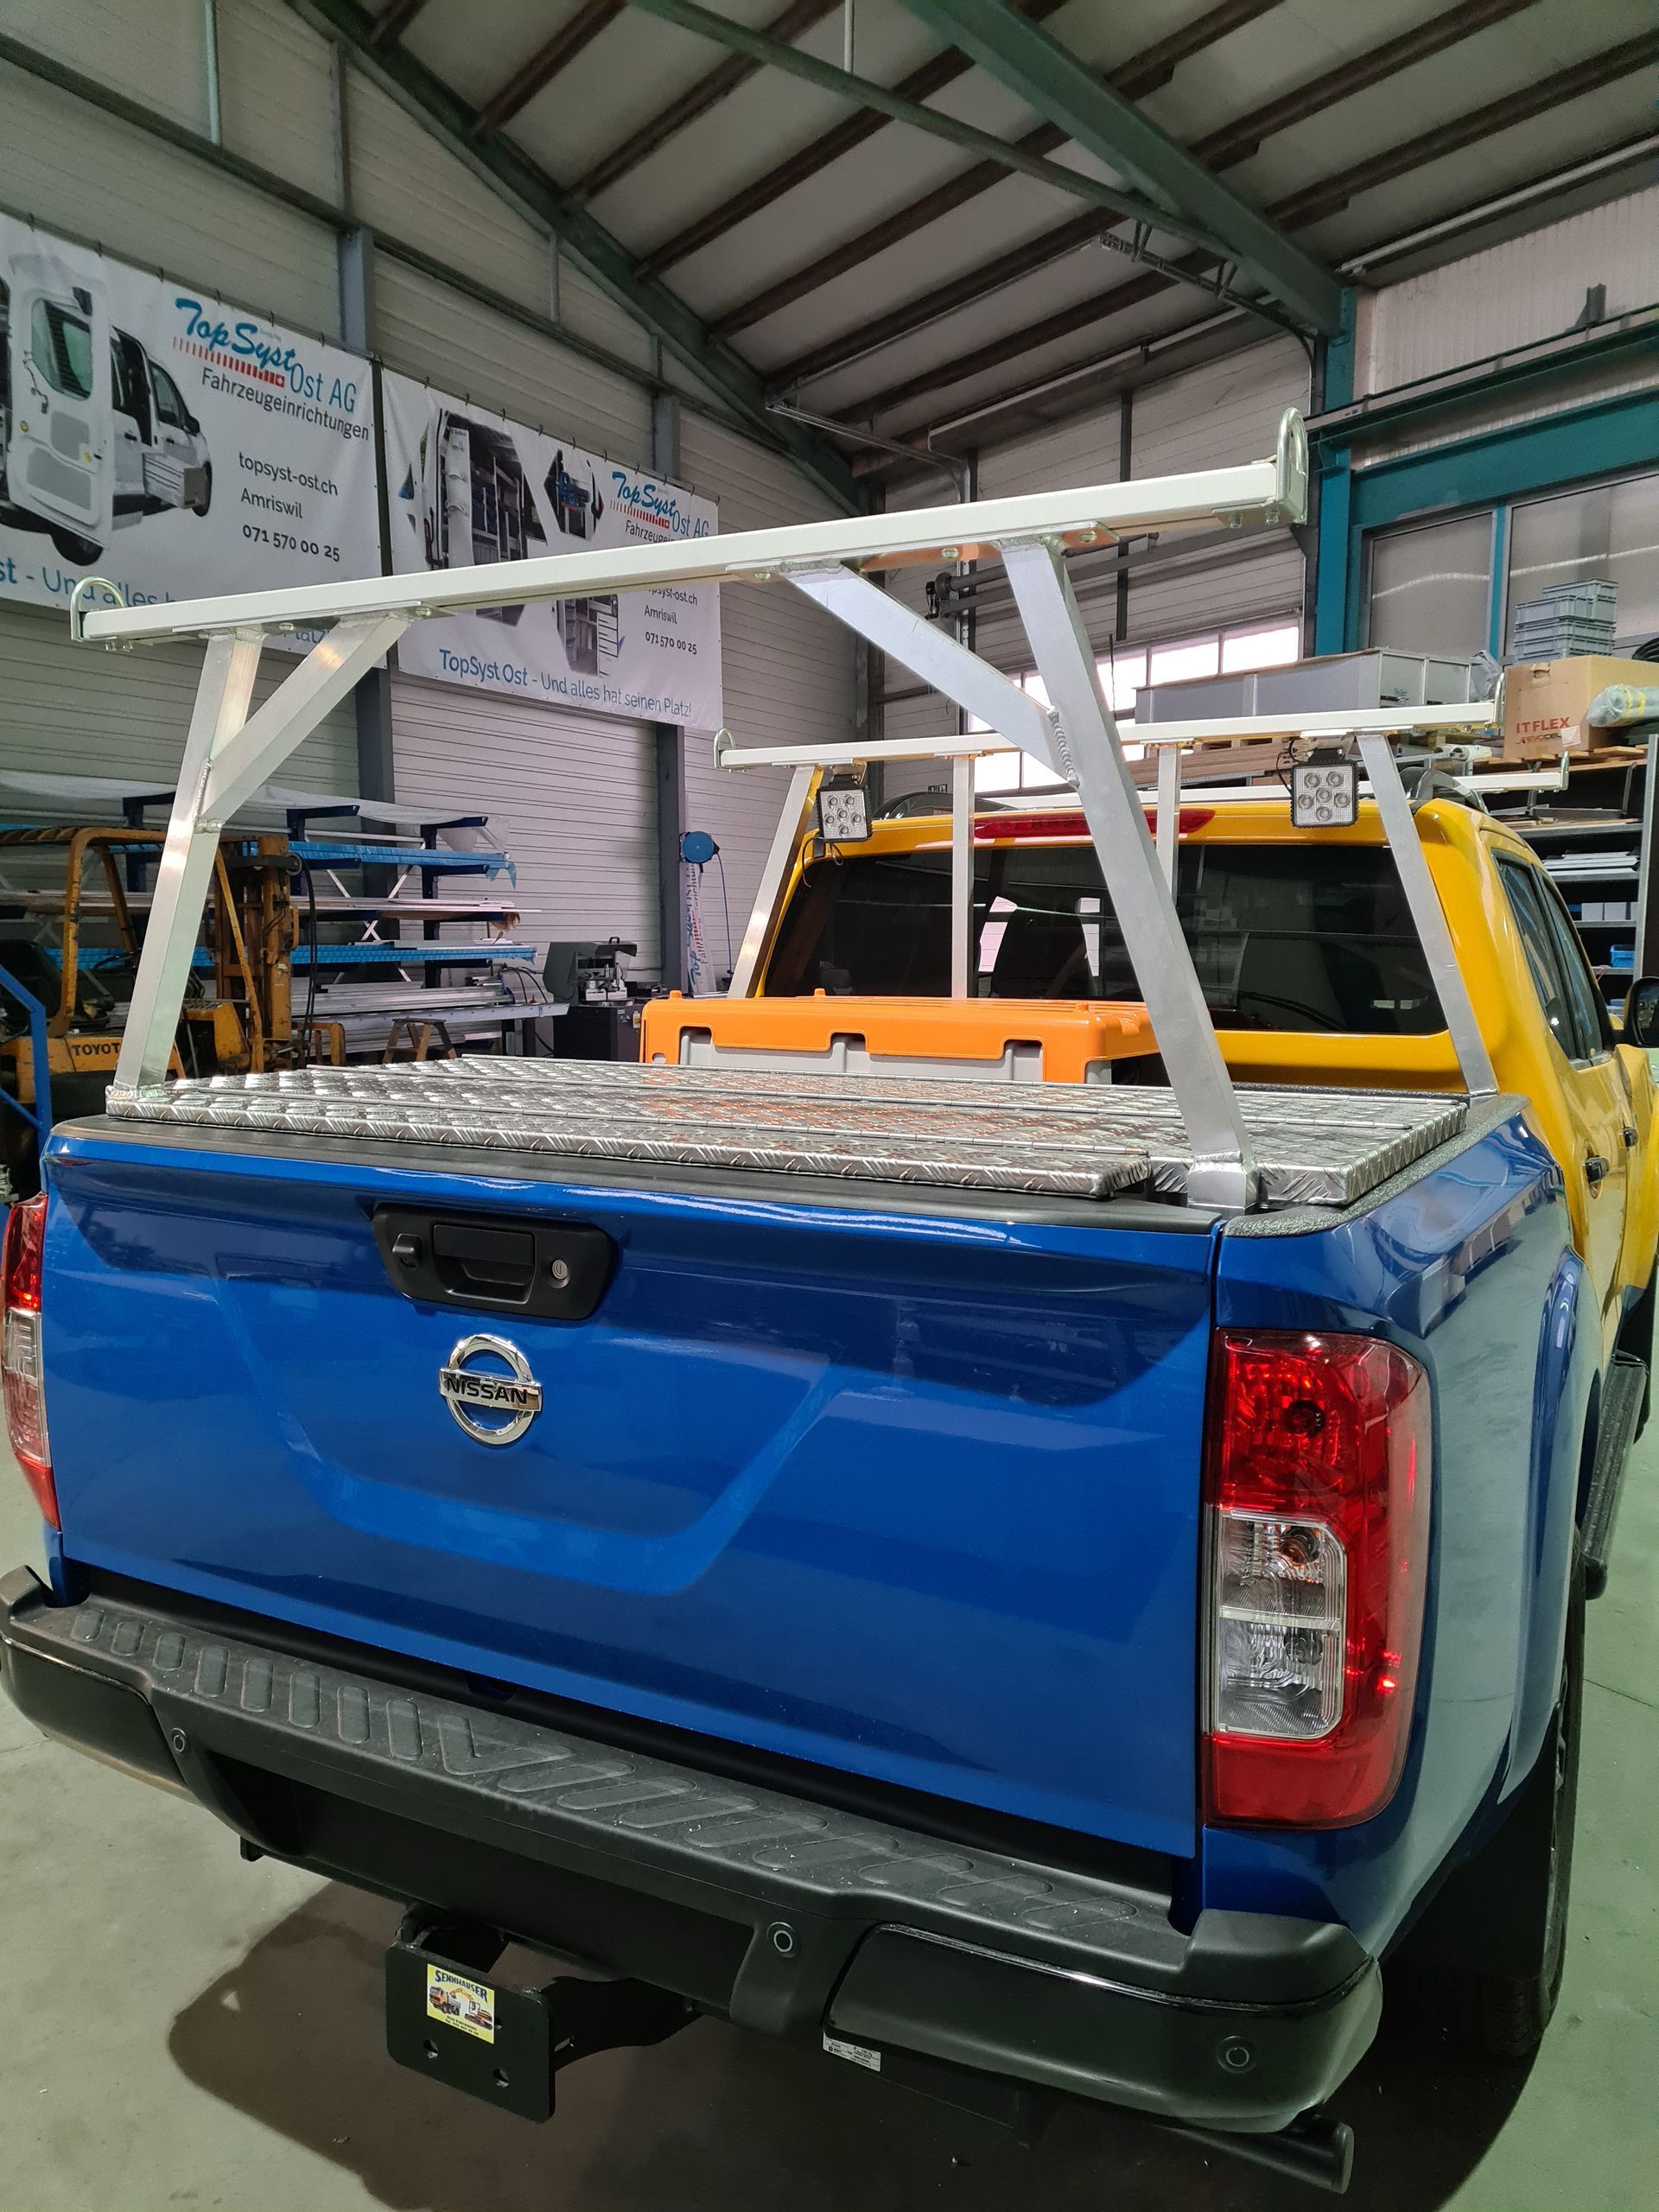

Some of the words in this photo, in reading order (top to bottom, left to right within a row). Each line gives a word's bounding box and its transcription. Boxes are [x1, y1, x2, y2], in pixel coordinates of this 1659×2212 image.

[175, 297, 296, 371] TopSyst
[290, 363, 324, 403] Ost
[328, 378, 357, 413] AG
[201, 367, 370, 441] Fahrzeugeinrichtungen
[238, 451, 338, 496] topsyst-ost.ch
[241, 487, 303, 518] Amriswil
[612, 471, 677, 517] TopSyst
[671, 510, 691, 537] Ost
[693, 518, 709, 537] AG
[243, 524, 270, 543] 071
[273, 532, 296, 550] 570
[301, 540, 319, 555] 00
[324, 545, 340, 563] 25
[644, 605, 677, 624] Amriswil
[645, 632, 658, 644] 071
[660, 636, 674, 648] 570
[677, 639, 686, 650] 00
[688, 643, 697, 655] 25
[439, 650, 499, 682] TopSyst
[503, 664, 527, 686] Ost
[540, 672, 567, 694] Und
[570, 680, 600, 700] alles
[603, 684, 621, 705] hat
[624, 691, 661, 711] seinen
[664, 698, 691, 717] Platz!
[72, 1042, 120, 1056] TOYOT
[445, 1377, 528, 1404] NISSAN
[435, 1970, 488, 2004] SENNHAUSER
